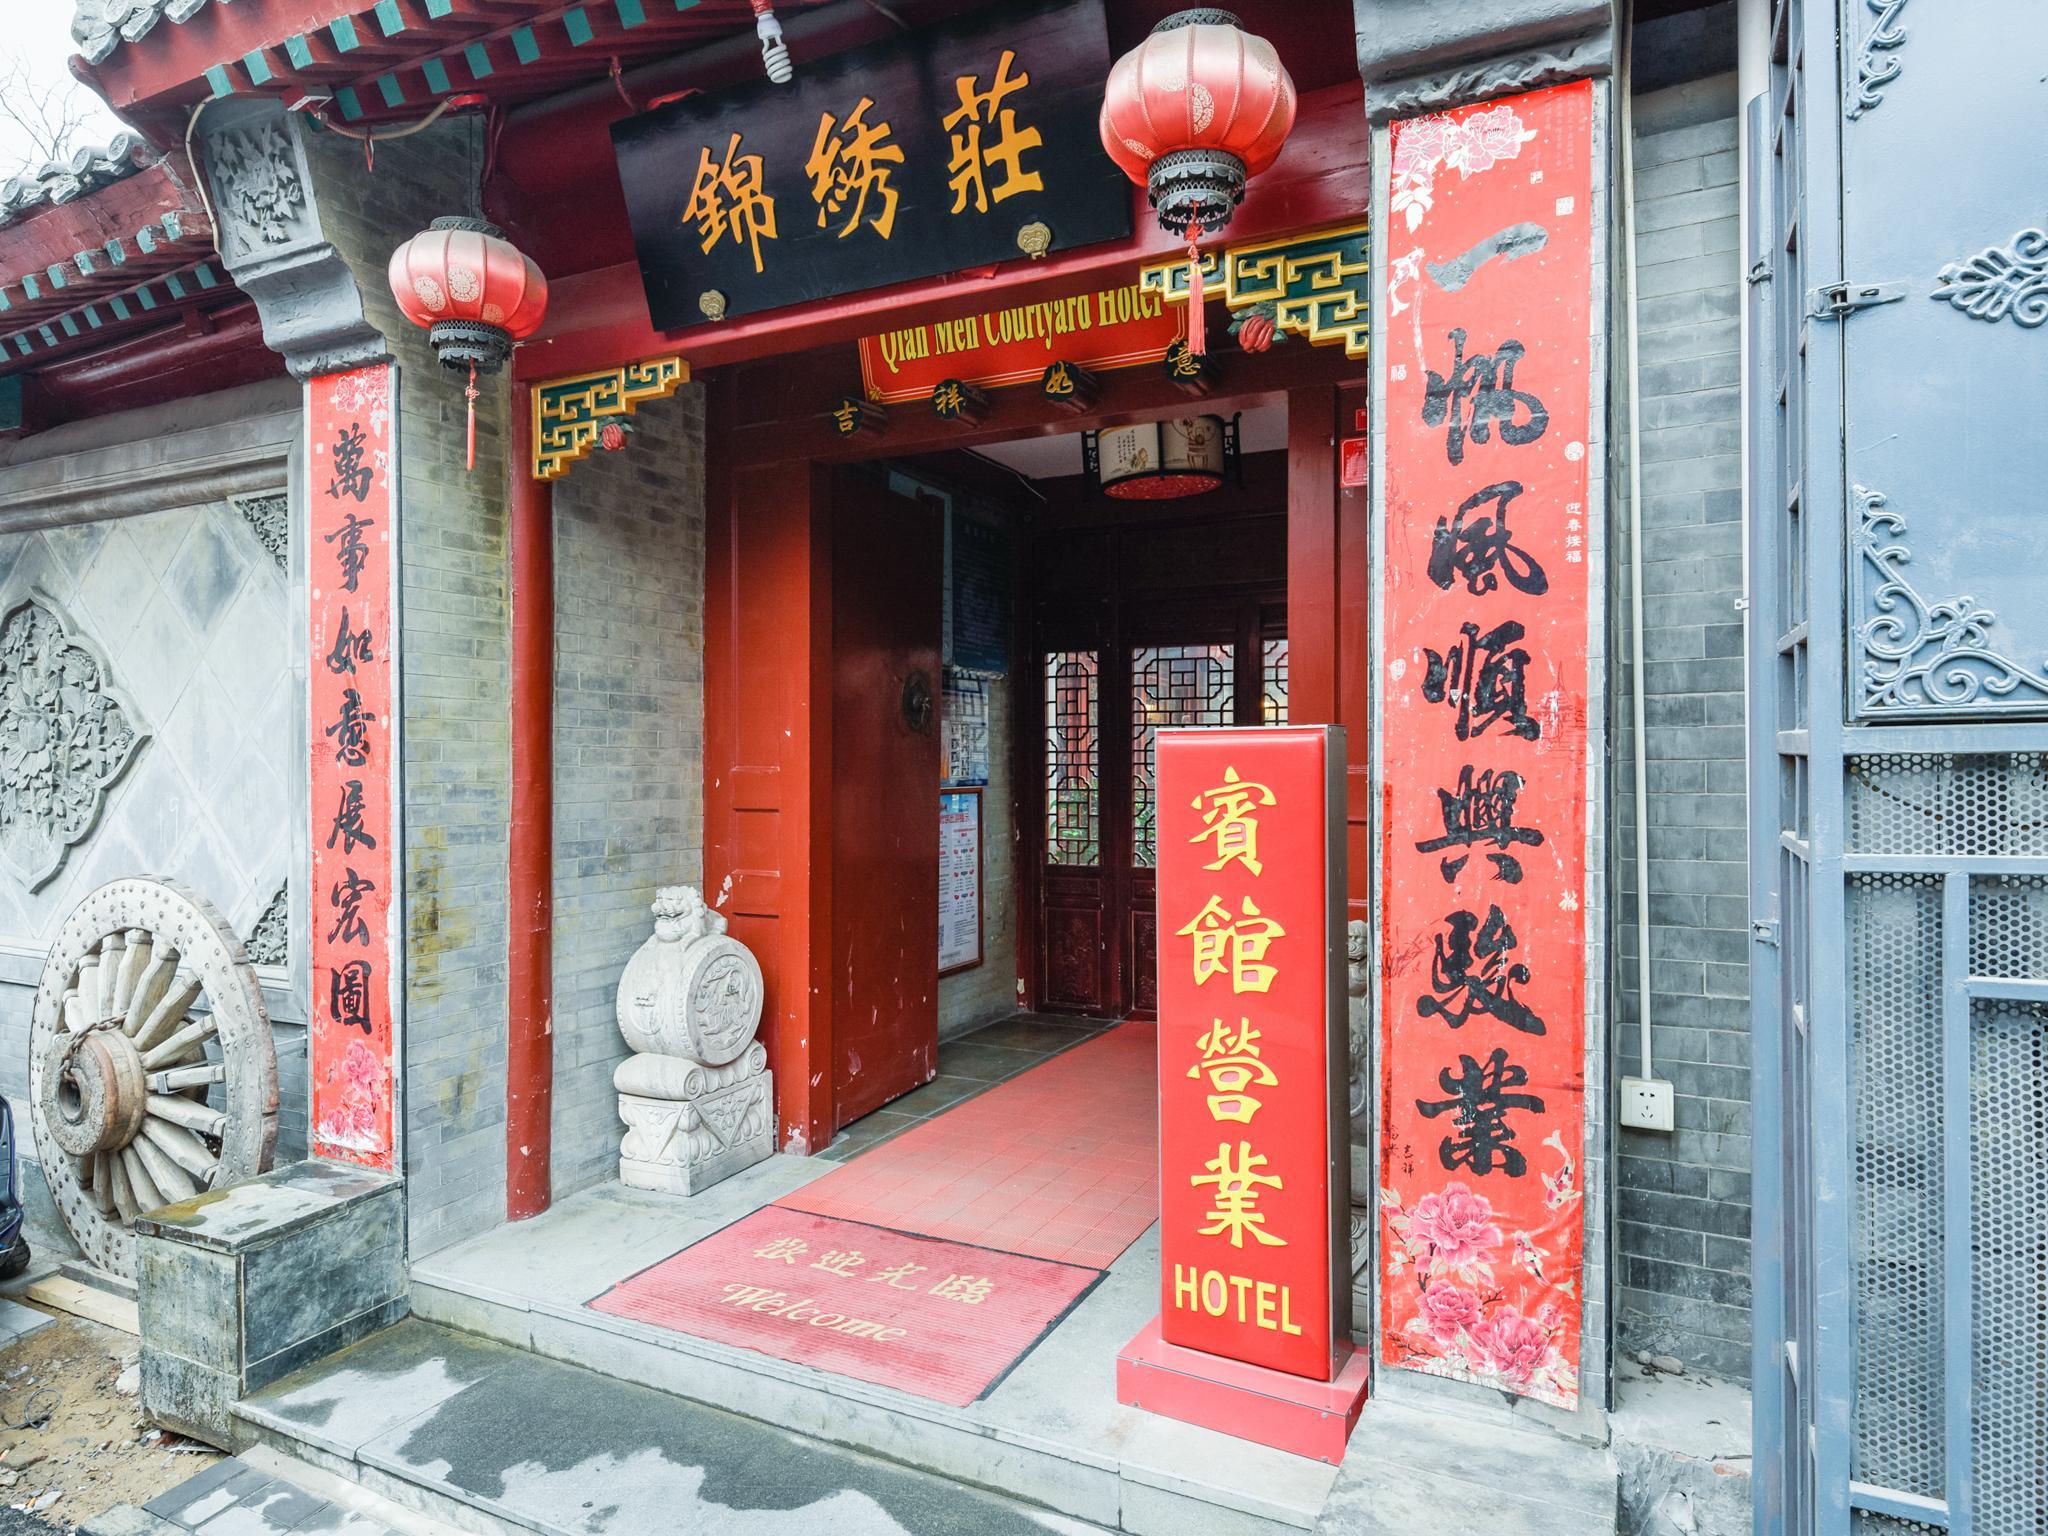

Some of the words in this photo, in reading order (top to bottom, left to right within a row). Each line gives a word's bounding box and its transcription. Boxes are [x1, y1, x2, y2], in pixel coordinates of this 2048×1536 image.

[880, 326, 930, 373] Qian
[934, 321, 980, 355] Men
[983, 294, 1092, 350] Courtyard
[1565, 502, 1582, 563] 迎春接福
[325, 423, 376, 1035] 萬事如意展宏圖
[1175, 766, 1287, 1249] 賓館營業
[720, 1283, 908, 1342] Welcome
[1175, 1264, 1302, 1336] HOTEL
